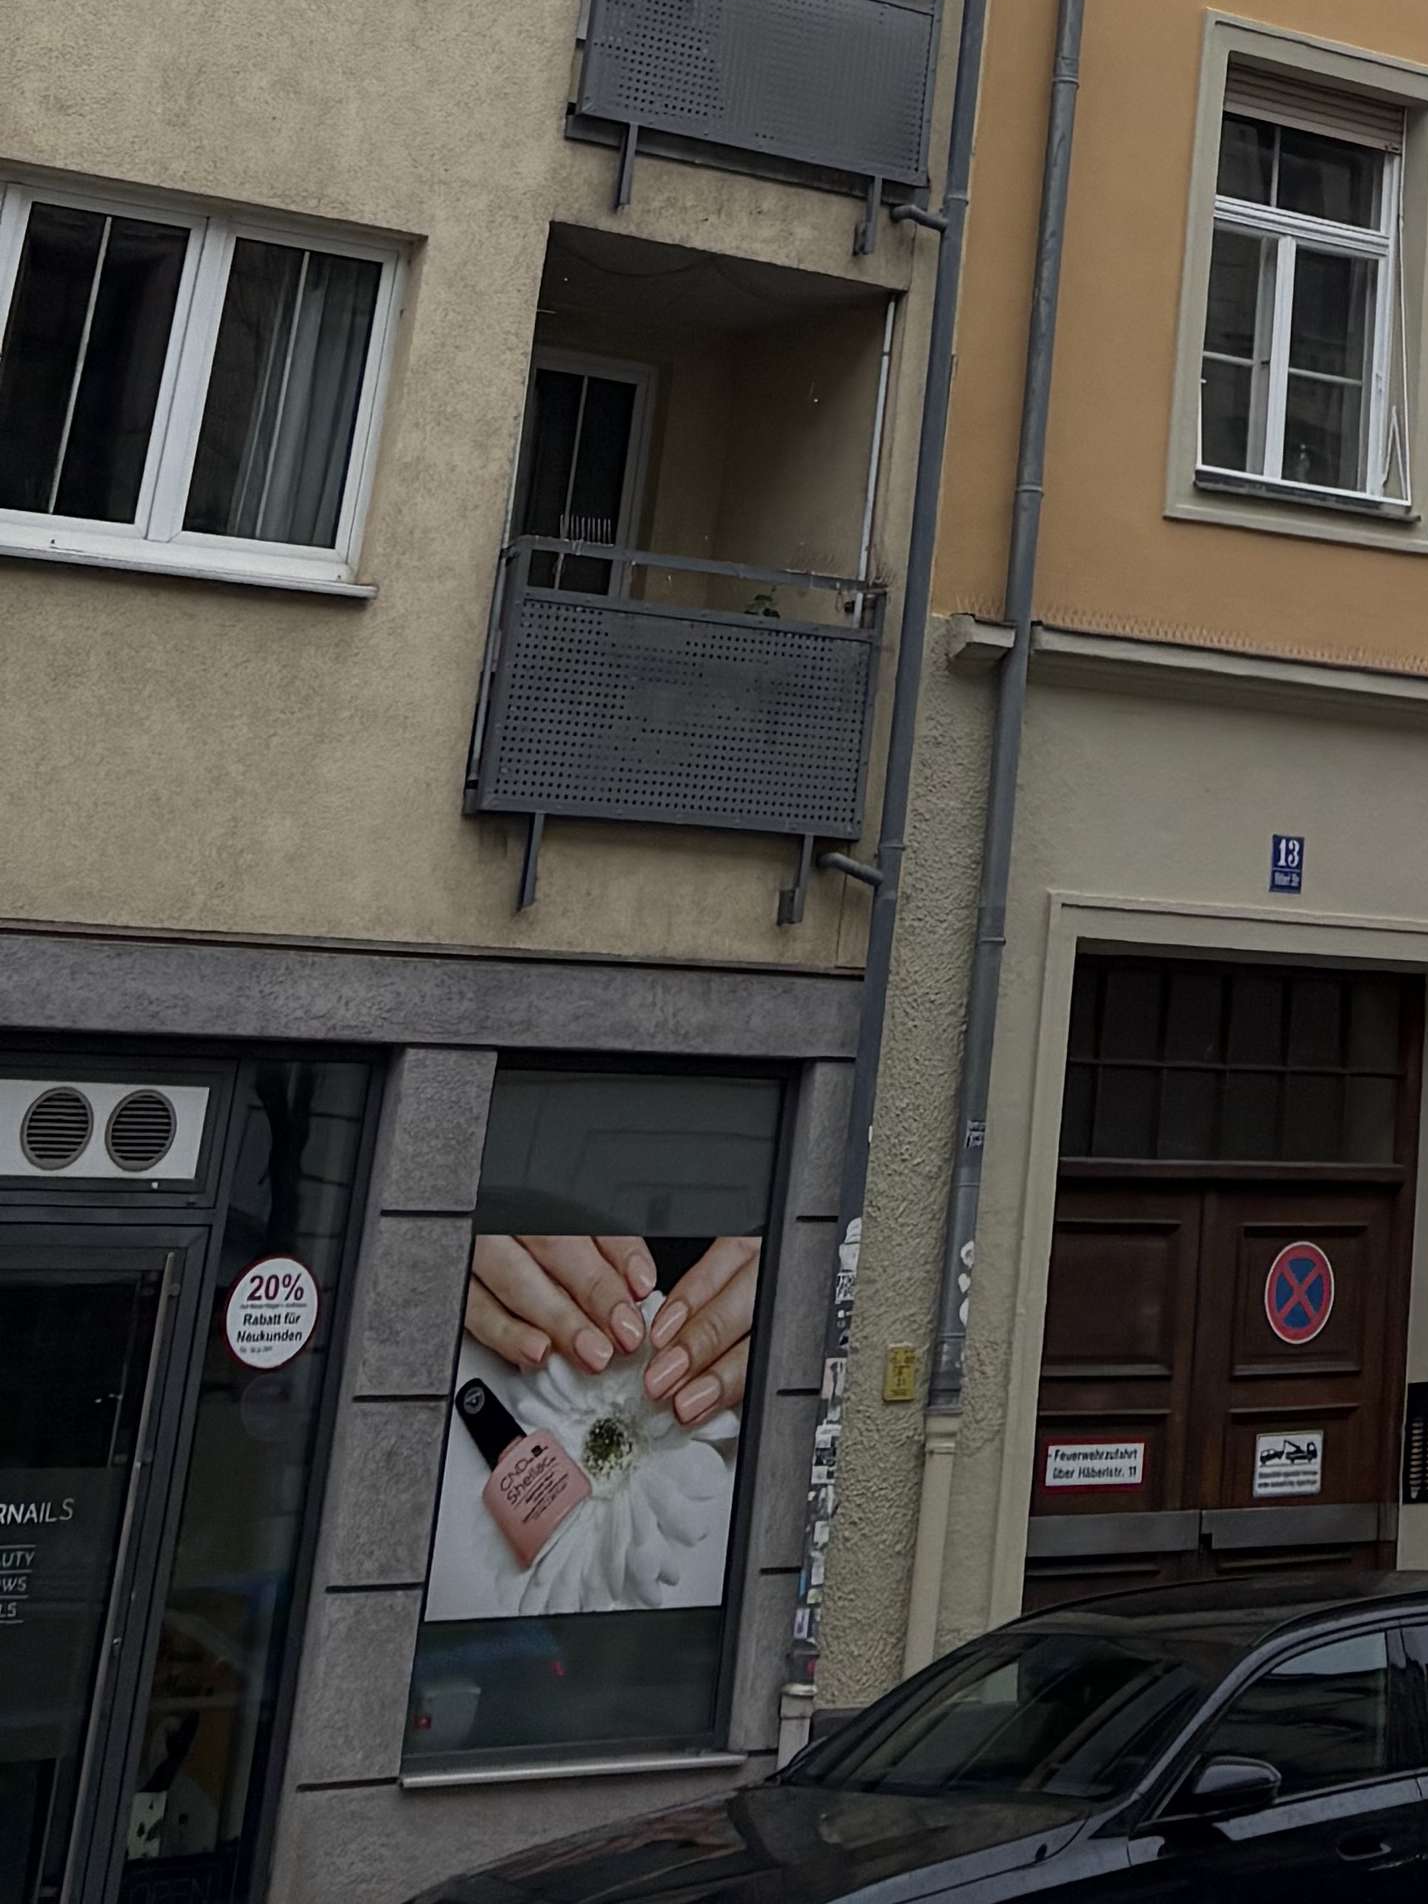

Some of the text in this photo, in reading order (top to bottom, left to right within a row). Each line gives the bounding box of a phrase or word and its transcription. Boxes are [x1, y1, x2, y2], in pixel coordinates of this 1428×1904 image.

[1277, 838, 1300, 867] 13
[246, 1273, 305, 1302] 20%
[242, 1311, 302, 1326] Rabatt für
[236, 1329, 303, 1343] Neukunden
[1053, 1466, 1075, 1480] über
